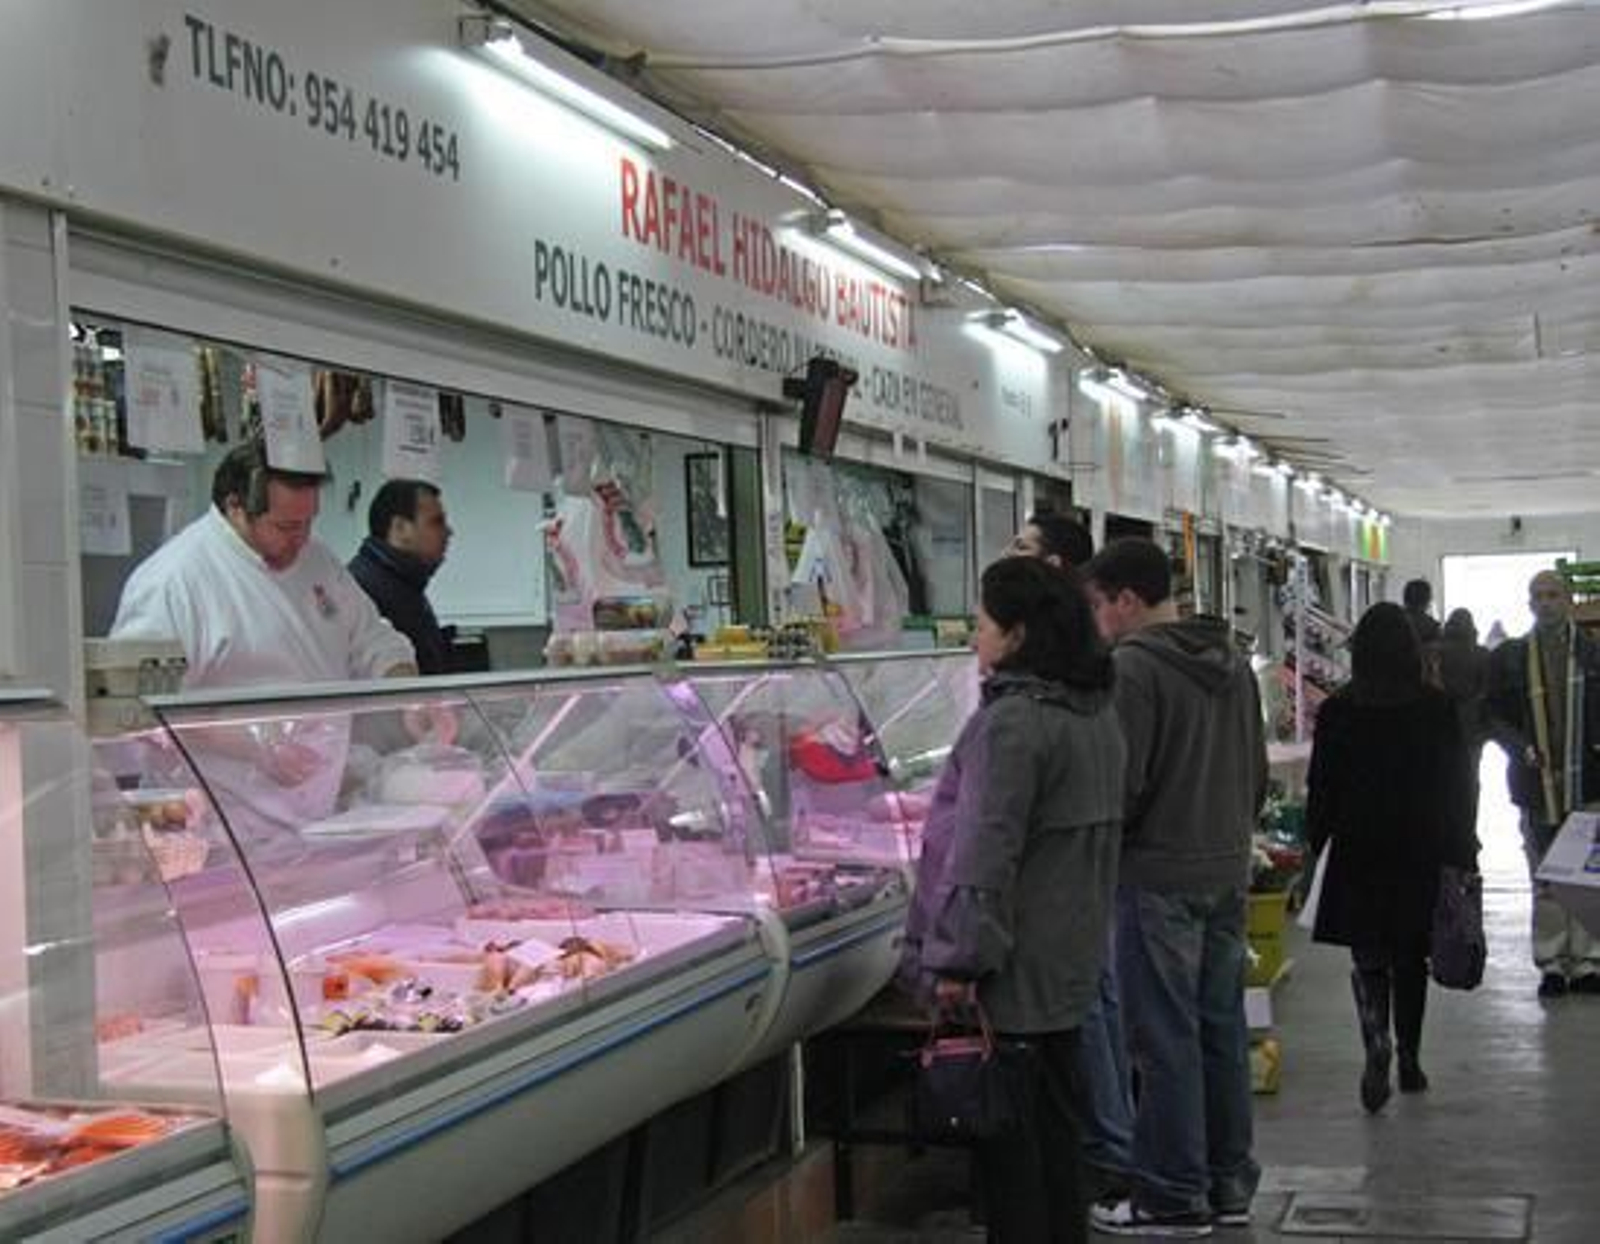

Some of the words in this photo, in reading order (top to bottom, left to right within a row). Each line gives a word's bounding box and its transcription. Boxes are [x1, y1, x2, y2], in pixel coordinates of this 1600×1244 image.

[184, 13, 298, 117] TLFNO:
[304, 71, 357, 141] 954
[364, 97, 410, 162] 419
[417, 120, 461, 182] 454
[534, 239, 612, 323] POLLO
[618, 269, 697, 350] FRESCO
[711, 303, 790, 374] CORDERO
[620, 158, 727, 277] RAFAEL
[732, 212, 831, 324] HIDALGO
